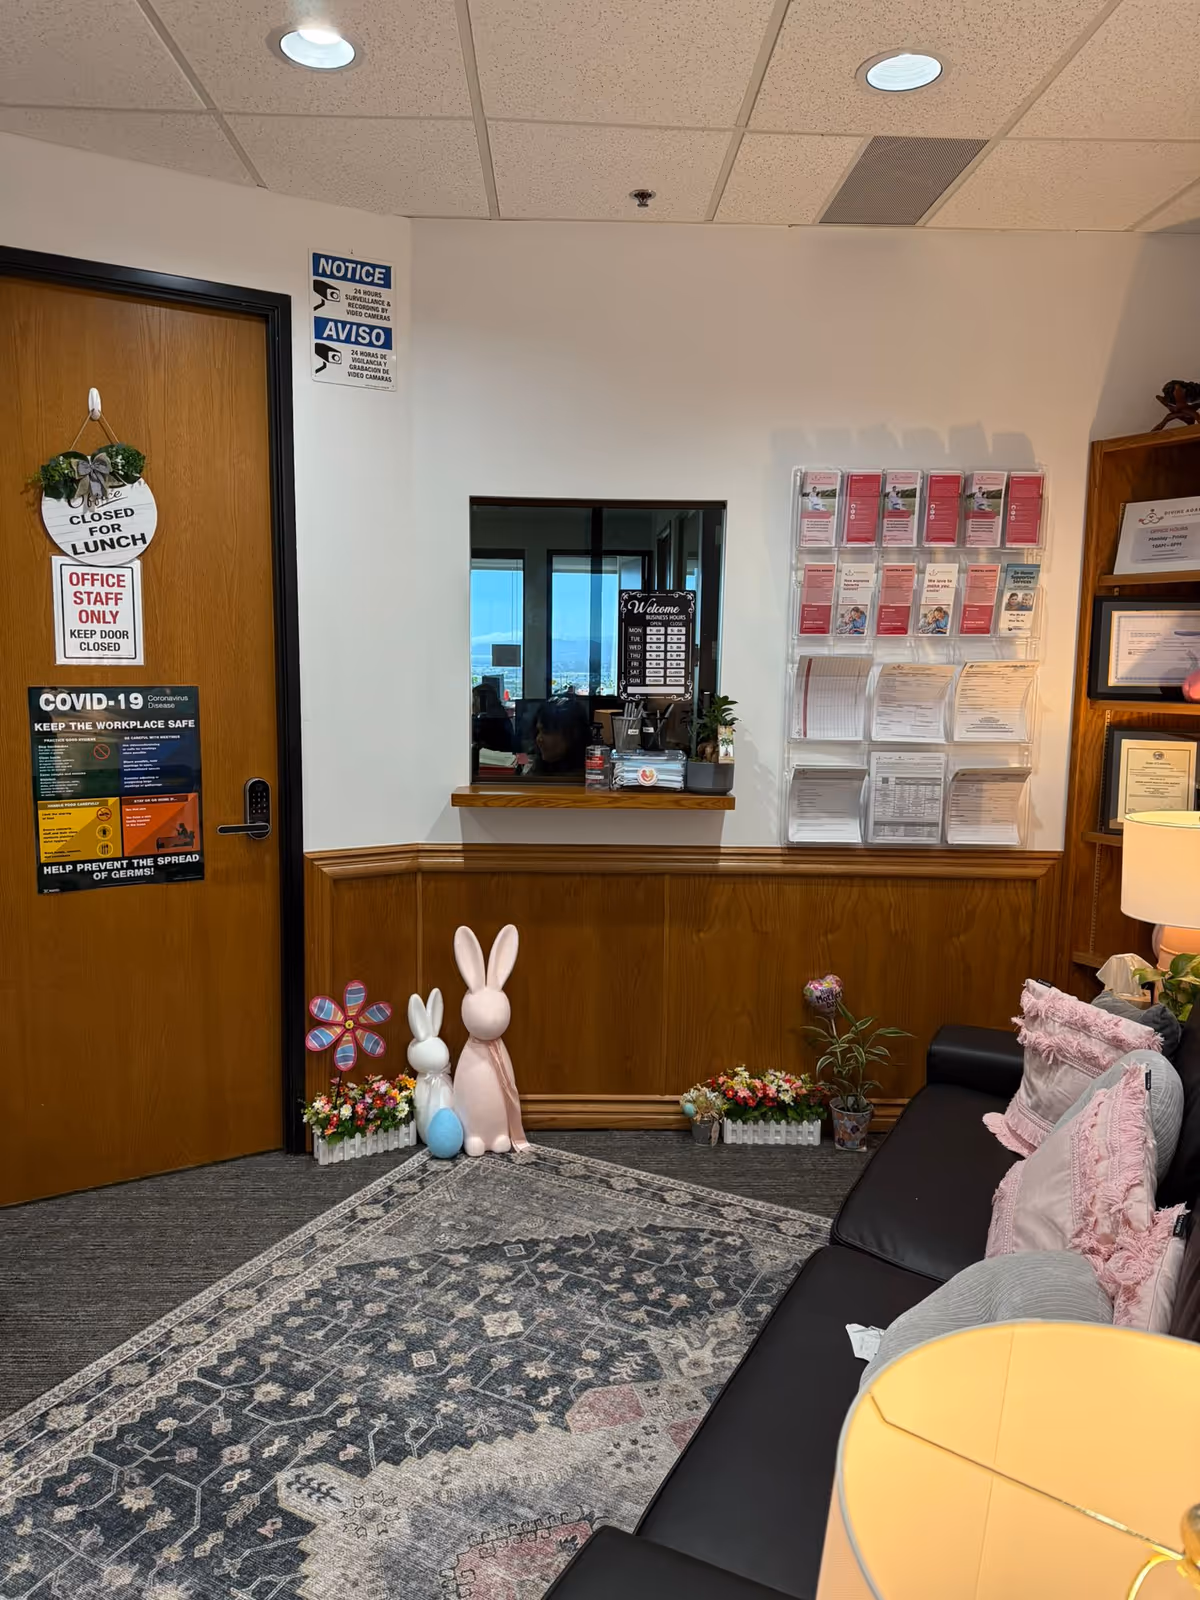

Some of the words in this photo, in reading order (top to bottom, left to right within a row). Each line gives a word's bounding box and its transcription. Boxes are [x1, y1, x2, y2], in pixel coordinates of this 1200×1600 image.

[318, 257, 386, 284] NOTICE
[345, 294, 385, 306] SURVEILLANCE
[362, 290, 382, 298] HOURS
[348, 302, 380, 312] RECORDING
[346, 309, 363, 317] VIDEO
[364, 312, 391, 321] CAMERAS
[322, 321, 384, 346] AVISO
[360, 351, 378, 359] HORAS
[349, 363, 381, 374] GRABACION
[351, 357, 382, 367] VIGILANCIA
[347, 371, 364, 379] VIDEO
[365, 374, 392, 382] CAMARAS
[69, 507, 135, 525] CLOSED
[88, 523, 123, 536] FOR
[71, 533, 148, 556] LUNCH
[69, 572, 126, 588] OFFICE
[73, 591, 123, 606] STAFF
[627, 598, 680, 614] Welcome
[78, 609, 120, 625] ONLY
[69, 629, 96, 640] KEEP
[100, 630, 129, 640] DOOR
[79, 642, 121, 652] CLOSED
[39, 692, 144, 712] COVID-19
[34, 722, 66, 732] KEEP
[69, 721, 93, 730] THE
[95, 720, 165, 730] WORKPLACE
[168, 719, 195, 728] SAFE
[43, 864, 73, 875] HELP
[77, 860, 128, 872] PREVENT
[131, 858, 154, 867] THE
[157, 854, 200, 865] SPREAD
[93, 871, 108, 880] OF
[111, 868, 154, 879] GERMS!
